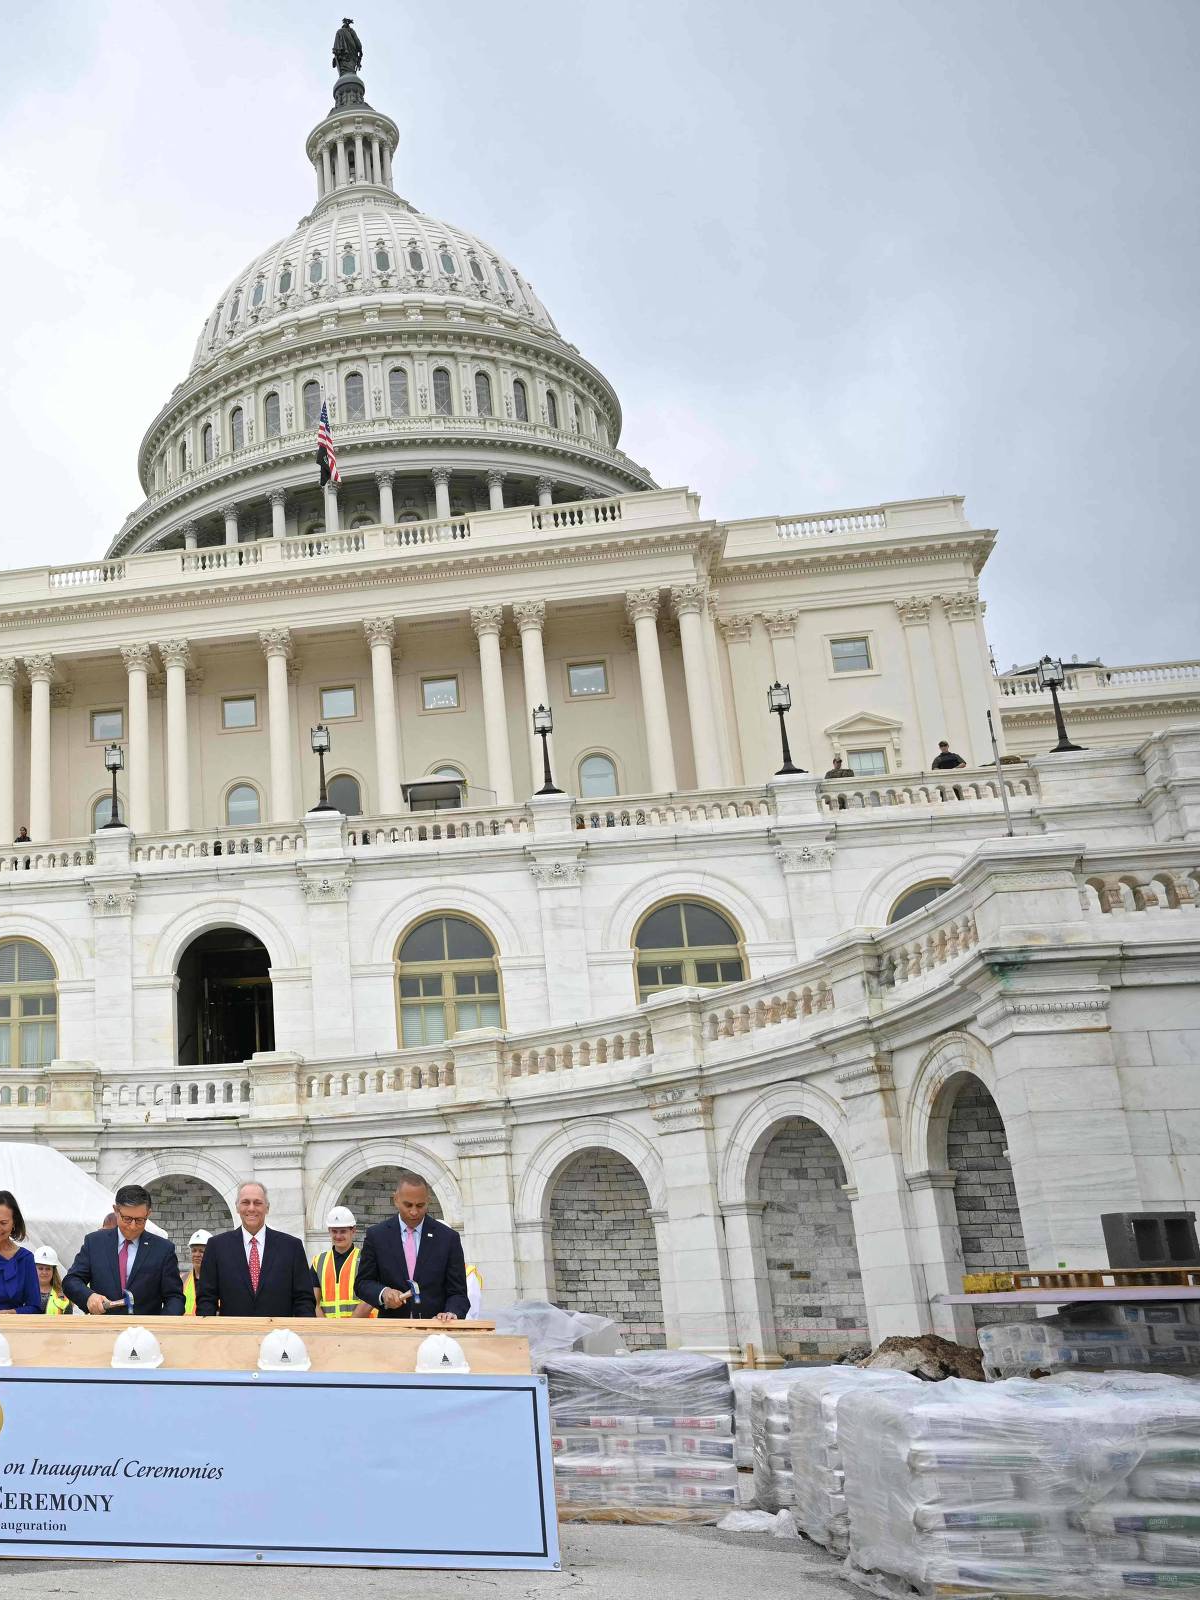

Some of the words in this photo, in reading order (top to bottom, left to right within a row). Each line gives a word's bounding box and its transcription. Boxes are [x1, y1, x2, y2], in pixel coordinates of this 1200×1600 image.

[3, 1463, 25, 1475] on
[30, 1457, 124, 1485] Inaugural
[124, 1460, 224, 1480] Ceremonies
